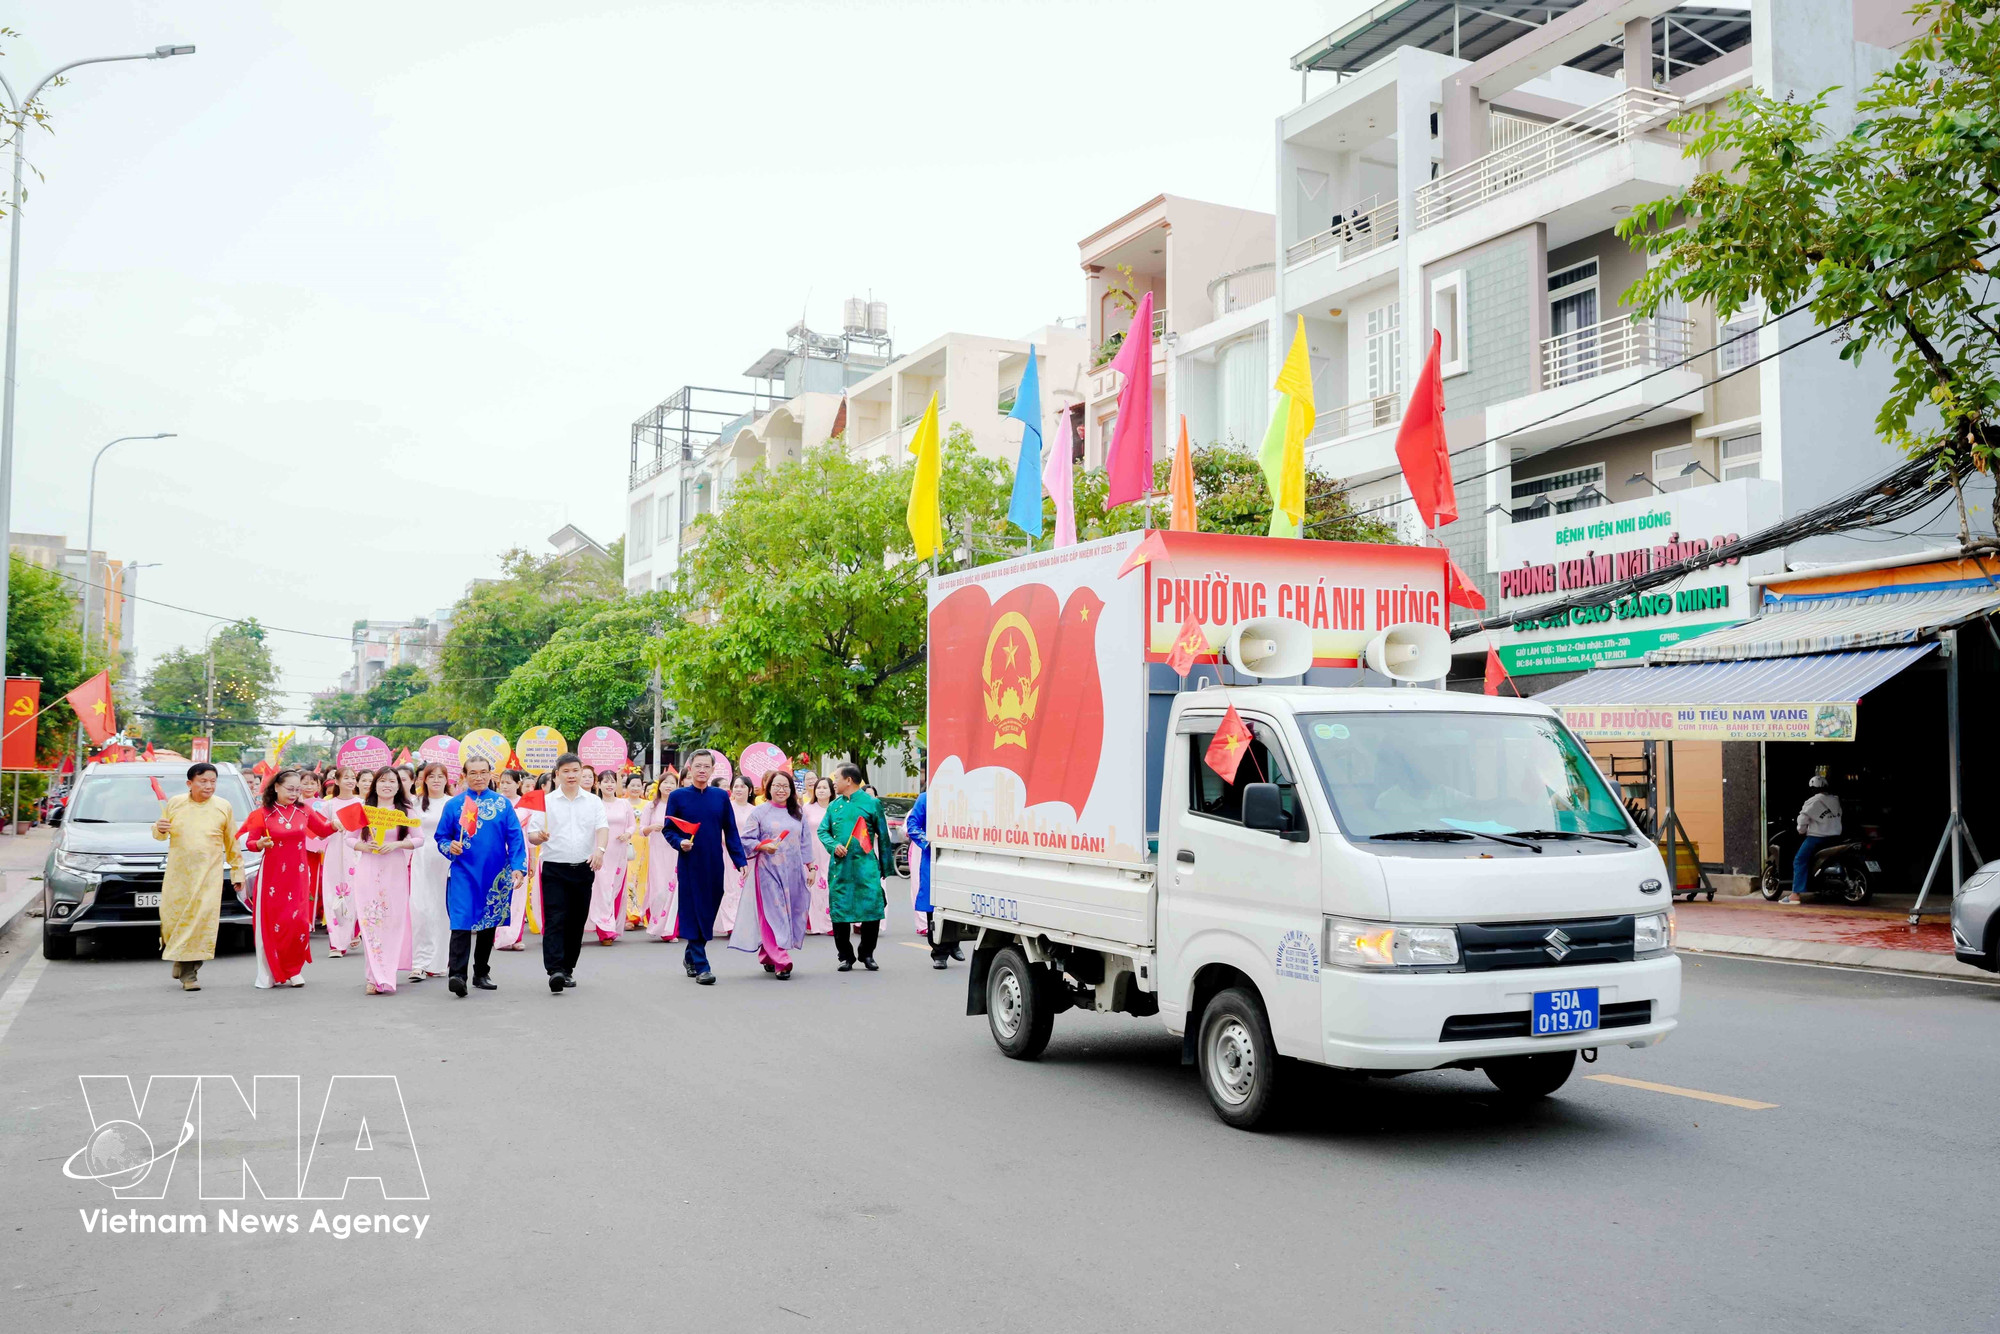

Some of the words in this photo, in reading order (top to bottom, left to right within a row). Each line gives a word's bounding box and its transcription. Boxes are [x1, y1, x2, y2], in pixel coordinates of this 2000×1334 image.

[1556, 526, 1585, 546] BỆNH
[1588, 520, 1614, 541] VIỆN
[1616, 518, 1635, 534] NHI
[1638, 509, 1671, 530] ĐỒNG
[1500, 560, 1556, 599] PHÒNG
[1559, 551, 1614, 590] KHÁM
[1616, 548, 1650, 582] NHI
[1156, 571, 1267, 626] PHƯỜNG
[1278, 577, 1365, 631] CHÁNH
[1376, 584, 1440, 631] HƯNG
[1571, 602, 1612, 625] CAO
[1676, 585, 1728, 612] MINH
[1527, 646, 1540, 656] LÀM
[1552, 655, 1567, 665] Liêm
[1566, 711, 1594, 728] HAI
[1600, 708, 1673, 729] PHƯƠNG
[1677, 706, 1695, 721] HỦ
[1699, 706, 1728, 721] TIẾU
[1732, 709, 1765, 720] NAM
[1770, 709, 1808, 720] VANG
[1678, 722, 1696, 731] CƠM
[936, 822, 949, 838] LÀ
[951, 823, 980, 841] NGÀY
[983, 825, 1002, 845] HỘI
[1005, 824, 1029, 846] CỦA
[1033, 830, 1067, 850] TOÀN
[1071, 833, 1105, 853] DÂN!
[1551, 990, 1581, 1011] 50A
[1539, 1009, 1592, 1033] 019.70
